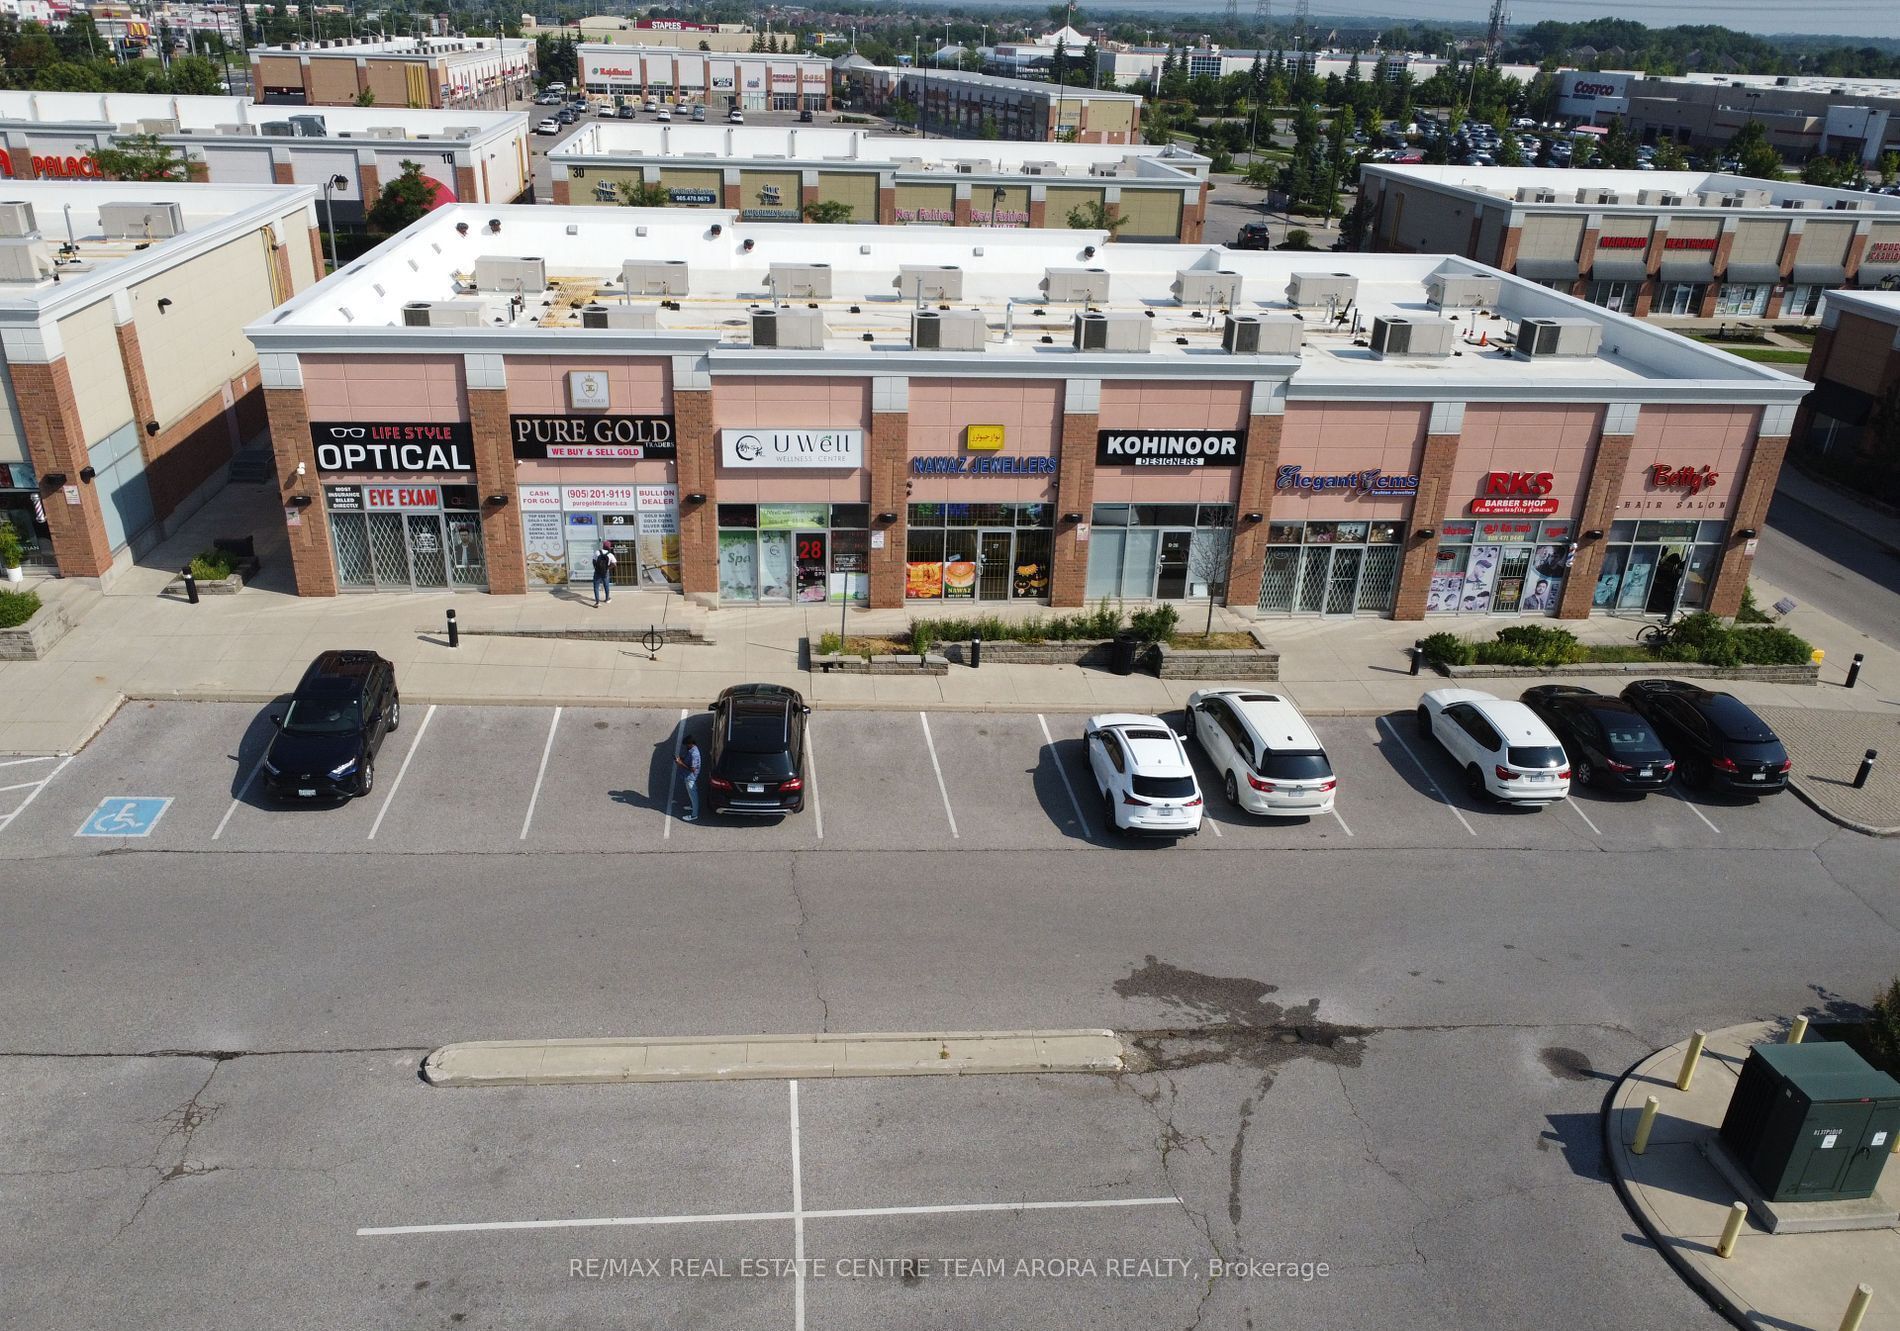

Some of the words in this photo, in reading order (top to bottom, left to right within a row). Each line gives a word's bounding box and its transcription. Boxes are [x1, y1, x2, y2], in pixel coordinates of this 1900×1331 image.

[652, 21, 682, 30] STAPLES
[441, 153, 454, 164] 10
[573, 167, 585, 178] 30
[919, 208, 954, 222] Fashion
[994, 209, 1030, 222] Fashion
[1870, 252, 1900, 261] FASHIO
[372, 426, 402, 440] LIFE
[405, 426, 452, 440] STYLE
[516, 419, 588, 442] PURE
[593, 419, 671, 442] GOLD
[645, 441, 676, 449] TRADERS
[1107, 436, 1237, 455] KOHINOOR
[317, 443, 471, 470] OPTICAL
[551, 448, 565, 457] WE
[567, 448, 585, 457] BUY
[586, 448, 594, 457] &
[595, 448, 615, 457] SELL
[617, 448, 641, 457] GOLD
[913, 456, 968, 474] NAWAZ
[971, 456, 1058, 474] JEWELLERS
[1140, 457, 1200, 465] DESIGNERS
[1277, 465, 1358, 492] Elegant
[1356, 468, 1420, 495] Gems
[1486, 471, 1554, 495] RKS
[1651, 464, 1720, 496] Betty's
[369, 488, 396, 507] EYE
[398, 488, 439, 507] EXAM
[568, 489, 589, 499] (905)
[590, 489, 632, 499] 201-9119
[572, 500, 629, 508] puregoldtraders.ca
[1624, 501, 1663, 509] HAIR
[1676, 501, 1727, 509] SALON
[612, 516, 625, 525] 29
[800, 541, 823, 559] 28
[728, 552, 751, 566] Spa
